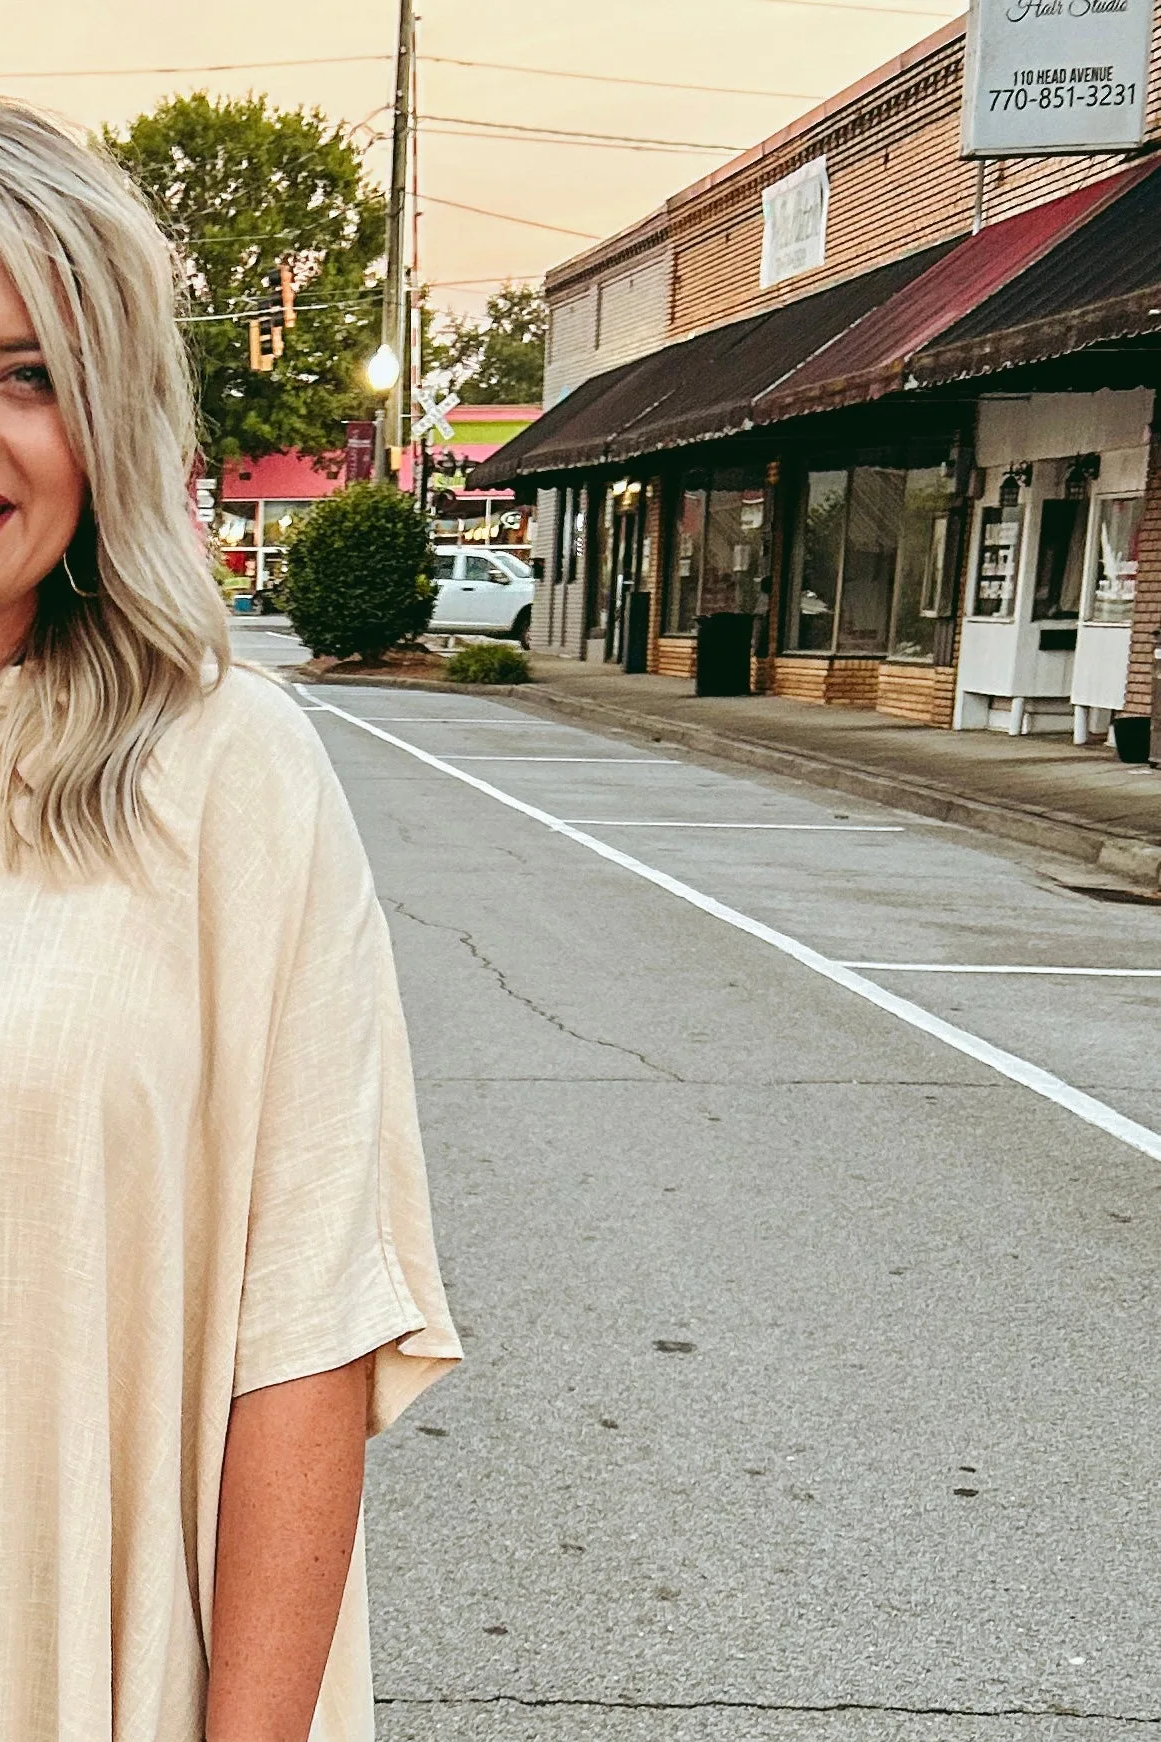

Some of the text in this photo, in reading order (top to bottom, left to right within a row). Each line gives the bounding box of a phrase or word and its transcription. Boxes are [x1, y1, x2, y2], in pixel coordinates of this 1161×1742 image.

[1006, 0, 1063, 22] Hair
[1013, 66, 1114, 86] 110 HEAD AVENUE
[989, 83, 1136, 111] 770-851-3231
